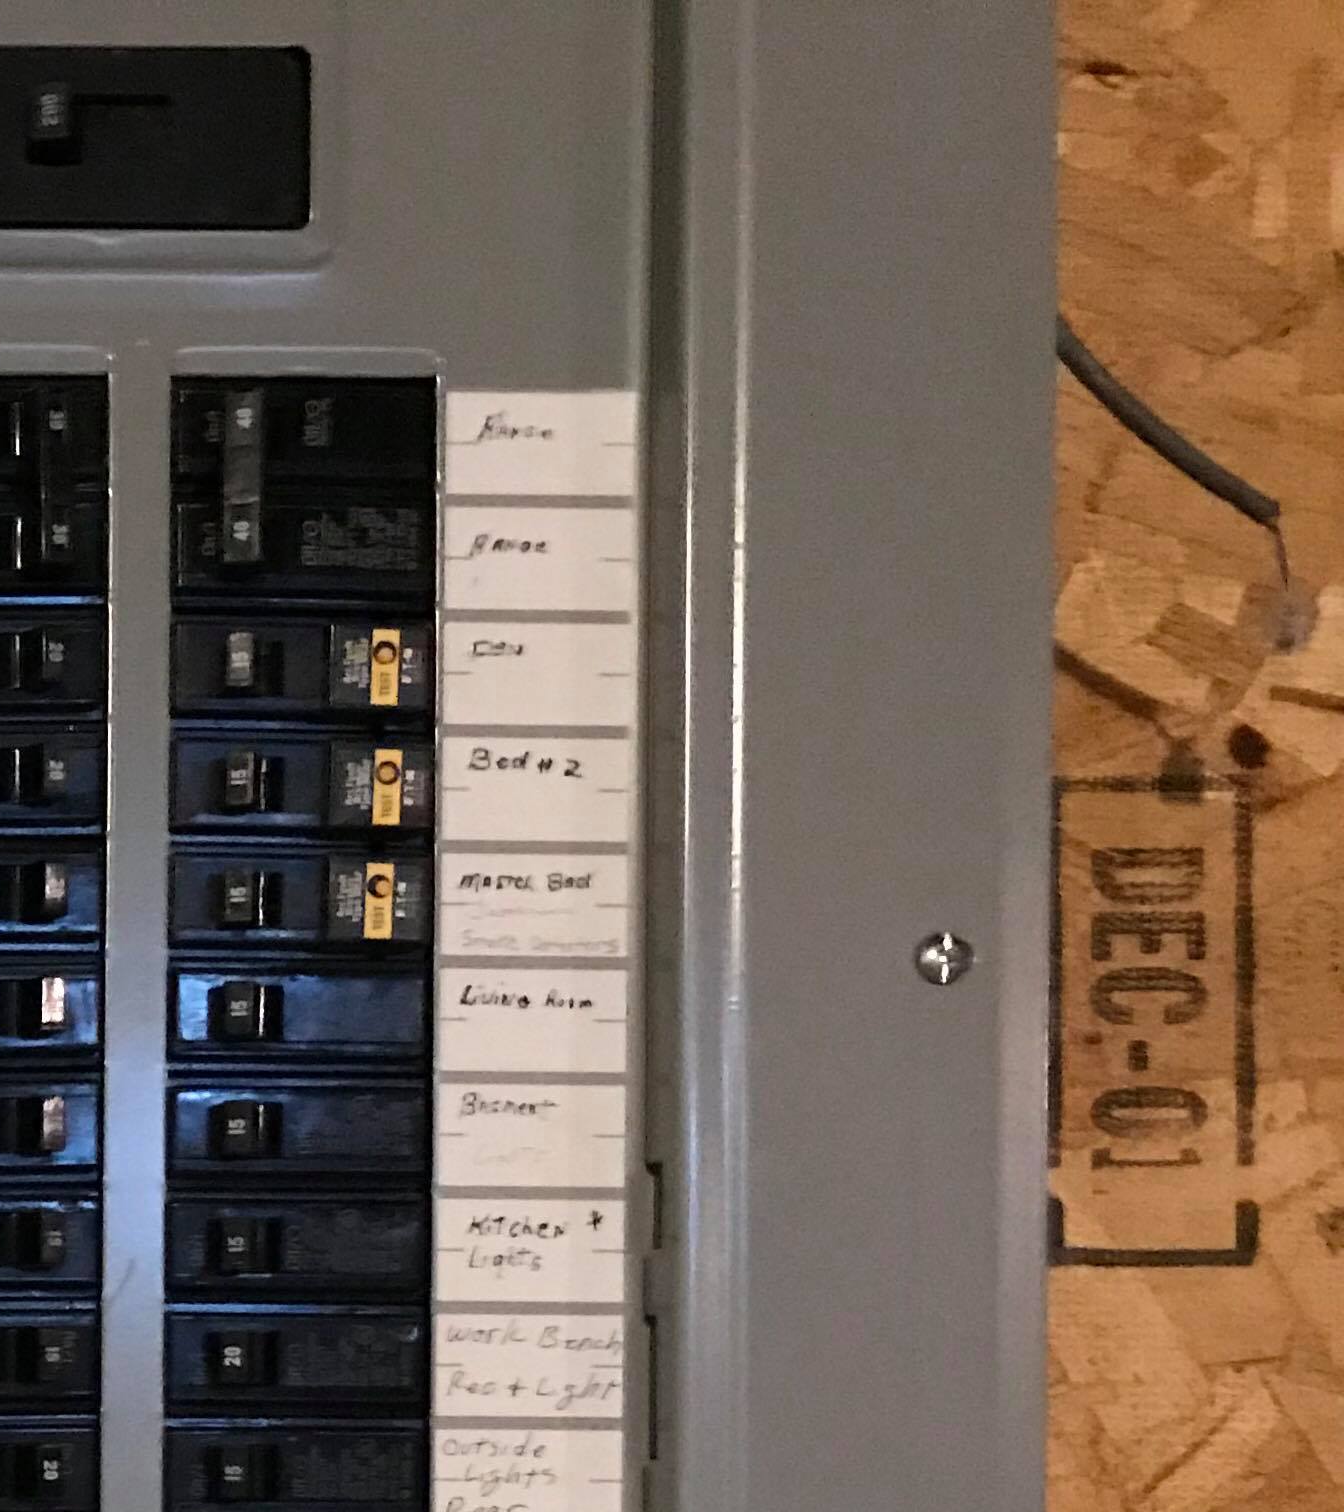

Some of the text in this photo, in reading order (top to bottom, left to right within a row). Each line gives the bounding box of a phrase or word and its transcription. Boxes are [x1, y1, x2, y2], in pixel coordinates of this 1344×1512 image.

[235, 407, 253, 428] 40
[233, 520, 250, 541] 40
[468, 748, 529, 771] Bed
[228, 1118, 246, 1135] 15
[228, 1235, 246, 1252] 15
[224, 1345, 242, 1367] 20
[43, 1461, 59, 1481] 20
